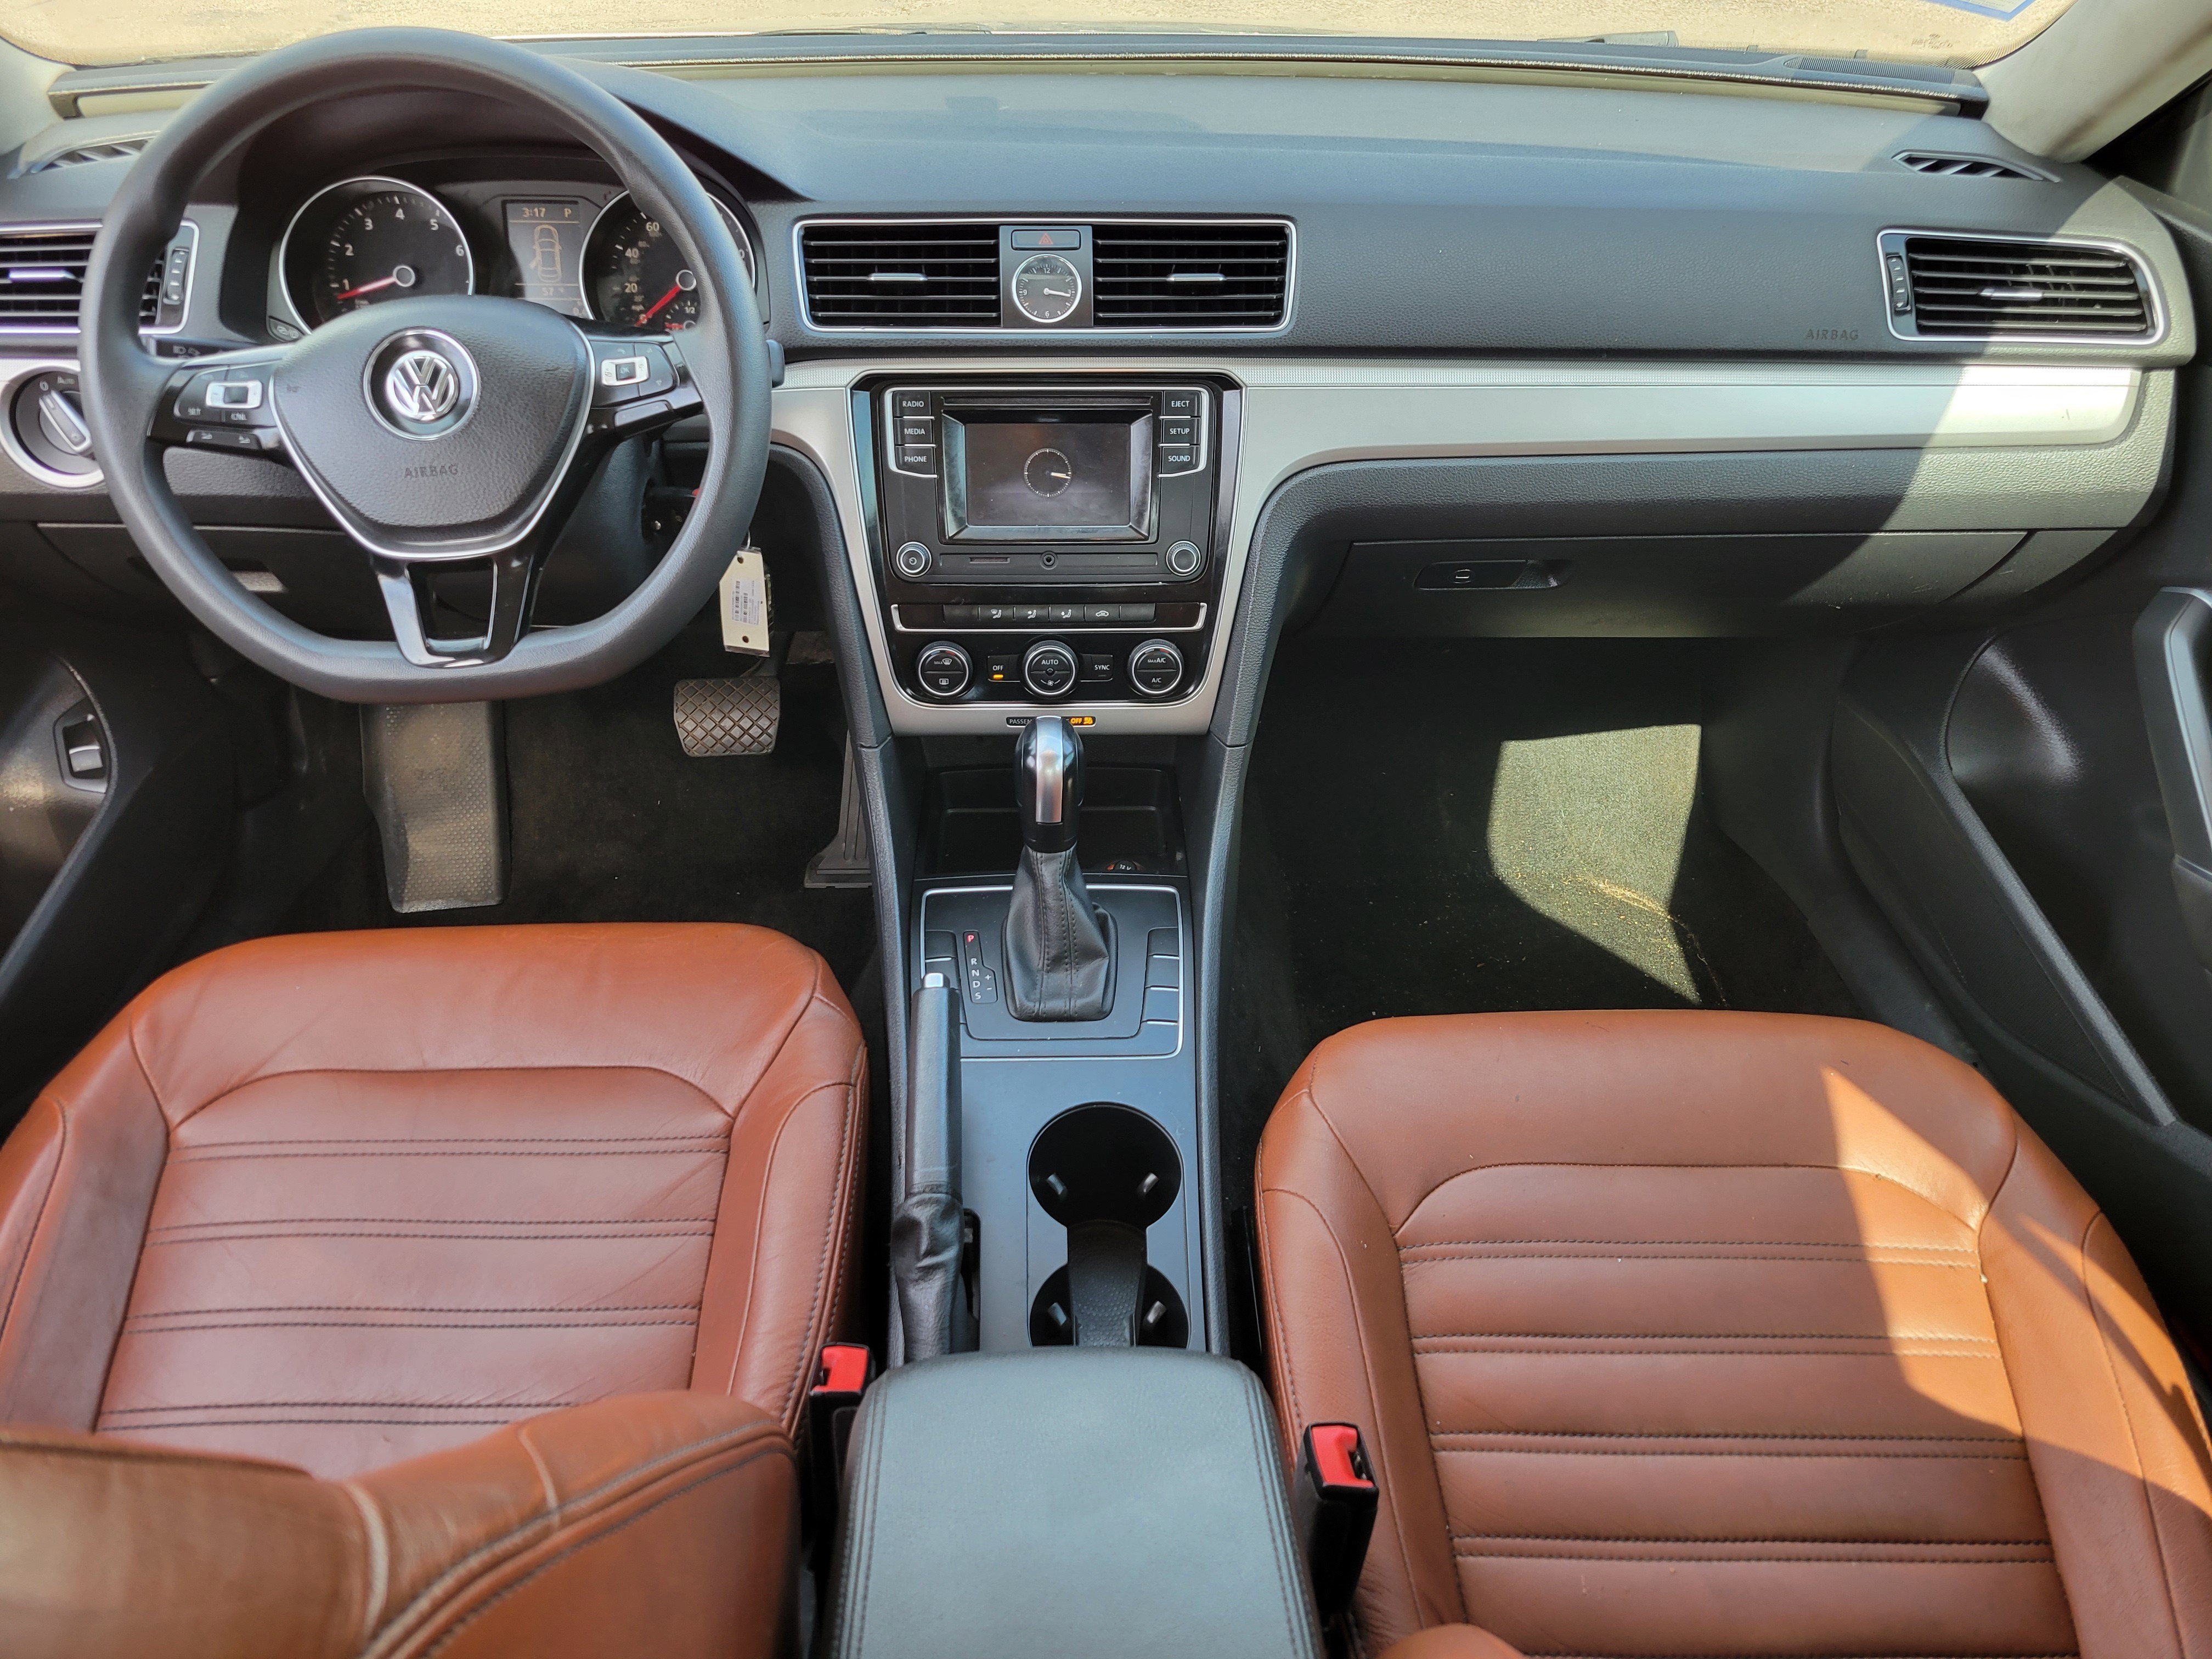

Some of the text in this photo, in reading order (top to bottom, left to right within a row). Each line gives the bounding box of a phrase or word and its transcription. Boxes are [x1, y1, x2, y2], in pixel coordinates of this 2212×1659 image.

[396, 208, 405, 220] 4
[522, 207, 546, 218] 3:17
[564, 208, 572, 218] P
[364, 218, 373, 230] 3
[430, 219, 438, 230] 5
[646, 222, 660, 232] 60
[344, 244, 354, 256] 2
[456, 245, 464, 256] 6
[624, 248, 639, 258] 40
[342, 279, 349, 290] 1
[624, 283, 637, 293] 20
[1805, 329, 1859, 340] AIRBAG
[403, 464, 459, 479] AIRBAG
